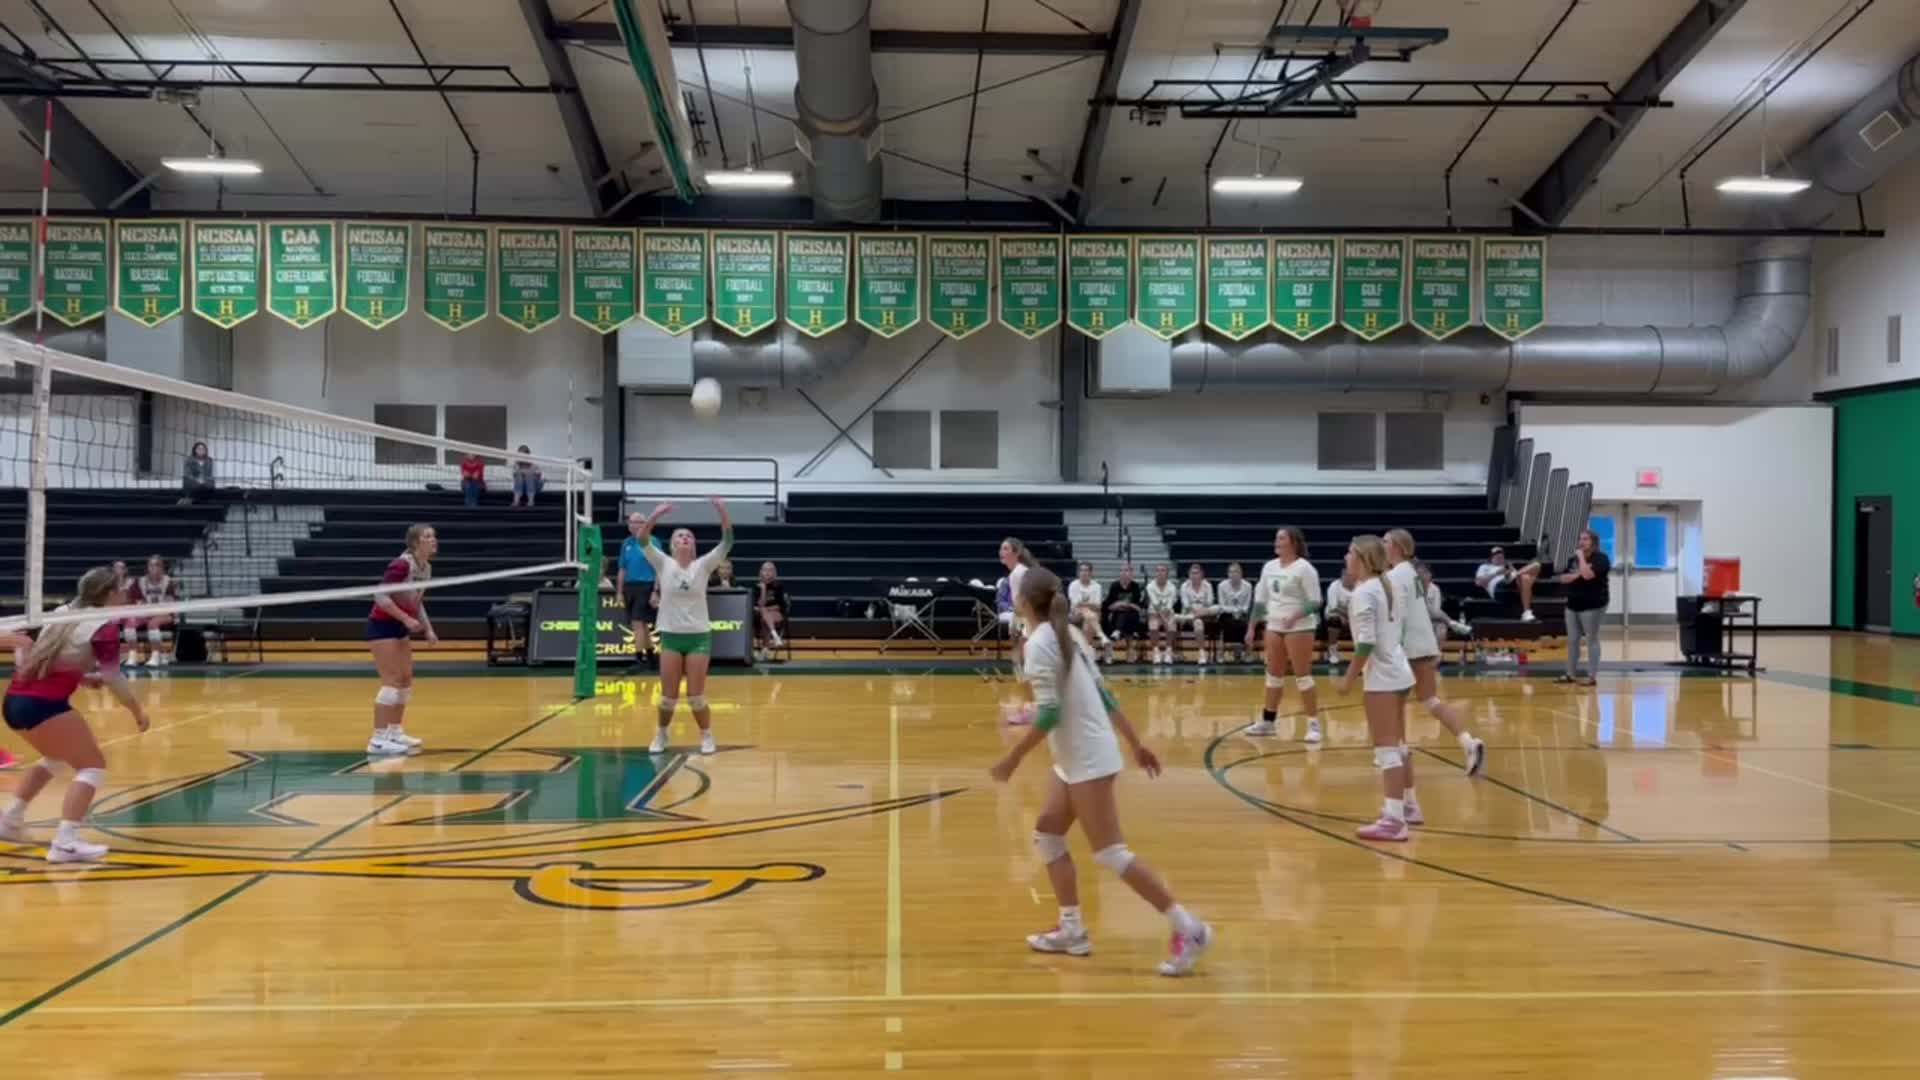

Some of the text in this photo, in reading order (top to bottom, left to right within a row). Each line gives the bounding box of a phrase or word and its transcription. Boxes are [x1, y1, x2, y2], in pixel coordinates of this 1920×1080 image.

[121, 228, 177, 241] NCISAA
[198, 230, 254, 243] NCISAA
[282, 231, 320, 244] CAA
[349, 231, 404, 244] NCISAA
[428, 233, 484, 248] NCISAA
[501, 234, 557, 248] NCISAA
[575, 236, 631, 250] NCISAA
[646, 238, 701, 251] NCISAA
[717, 239, 772, 253] NCISAA
[789, 240, 844, 254] NCISAA
[861, 242, 914, 256] NCISAA
[1003, 243, 1056, 256] NCISAA
[1072, 243, 1125, 256] NCISAA
[933, 243, 986, 257] NCISAA
[1140, 244, 1193, 257] NCISAA
[1211, 244, 1264, 258] NCISAA
[1278, 244, 1331, 258] NCISAA
[1346, 245, 1399, 258] NCISAA
[1416, 245, 1467, 258] NCISAA
[1488, 245, 1539, 259] NCISAA
[130, 269, 169, 280] BASEBALL
[358, 271, 396, 283] FOOTBALL
[436, 273, 475, 286] FOOTBALL
[510, 274, 548, 287] FOOTBALL
[585, 276, 623, 289] FOOTBALL
[656, 278, 693, 290] FOOTBALL
[726, 279, 763, 292] FOOTBALL
[797, 280, 834, 293] FOOTBALL
[869, 281, 906, 294] FOOTBALL
[1011, 283, 1048, 295] FOOTBALL
[1080, 283, 1116, 295] FOOTBALL
[940, 283, 977, 296] FOOTBALL
[1149, 283, 1185, 296] FOOTBALL
[1219, 283, 1256, 296] FOOTBALL
[1293, 284, 1313, 296] GOLF
[1361, 284, 1382, 296] GOLF
[67, 299, 79, 312] H
[145, 299, 156, 312] H
[221, 300, 233, 313] H
[296, 300, 308, 314] H
[371, 301, 383, 315] H
[450, 304, 461, 318] H
[524, 305, 536, 319] H
[598, 306, 610, 320] H
[668, 307, 680, 321] H
[739, 309, 751, 323] H
[811, 310, 822, 324] H
[882, 311, 894, 325] H
[953, 312, 964, 326] H
[1024, 312, 1036, 326] H
[1092, 312, 1104, 326] H
[1434, 312, 1446, 327] H
[1506, 312, 1519, 327] H
[1161, 313, 1173, 327] H
[1232, 313, 1243, 327] H
[1297, 313, 1308, 327] H
[1366, 313, 1376, 328] H
